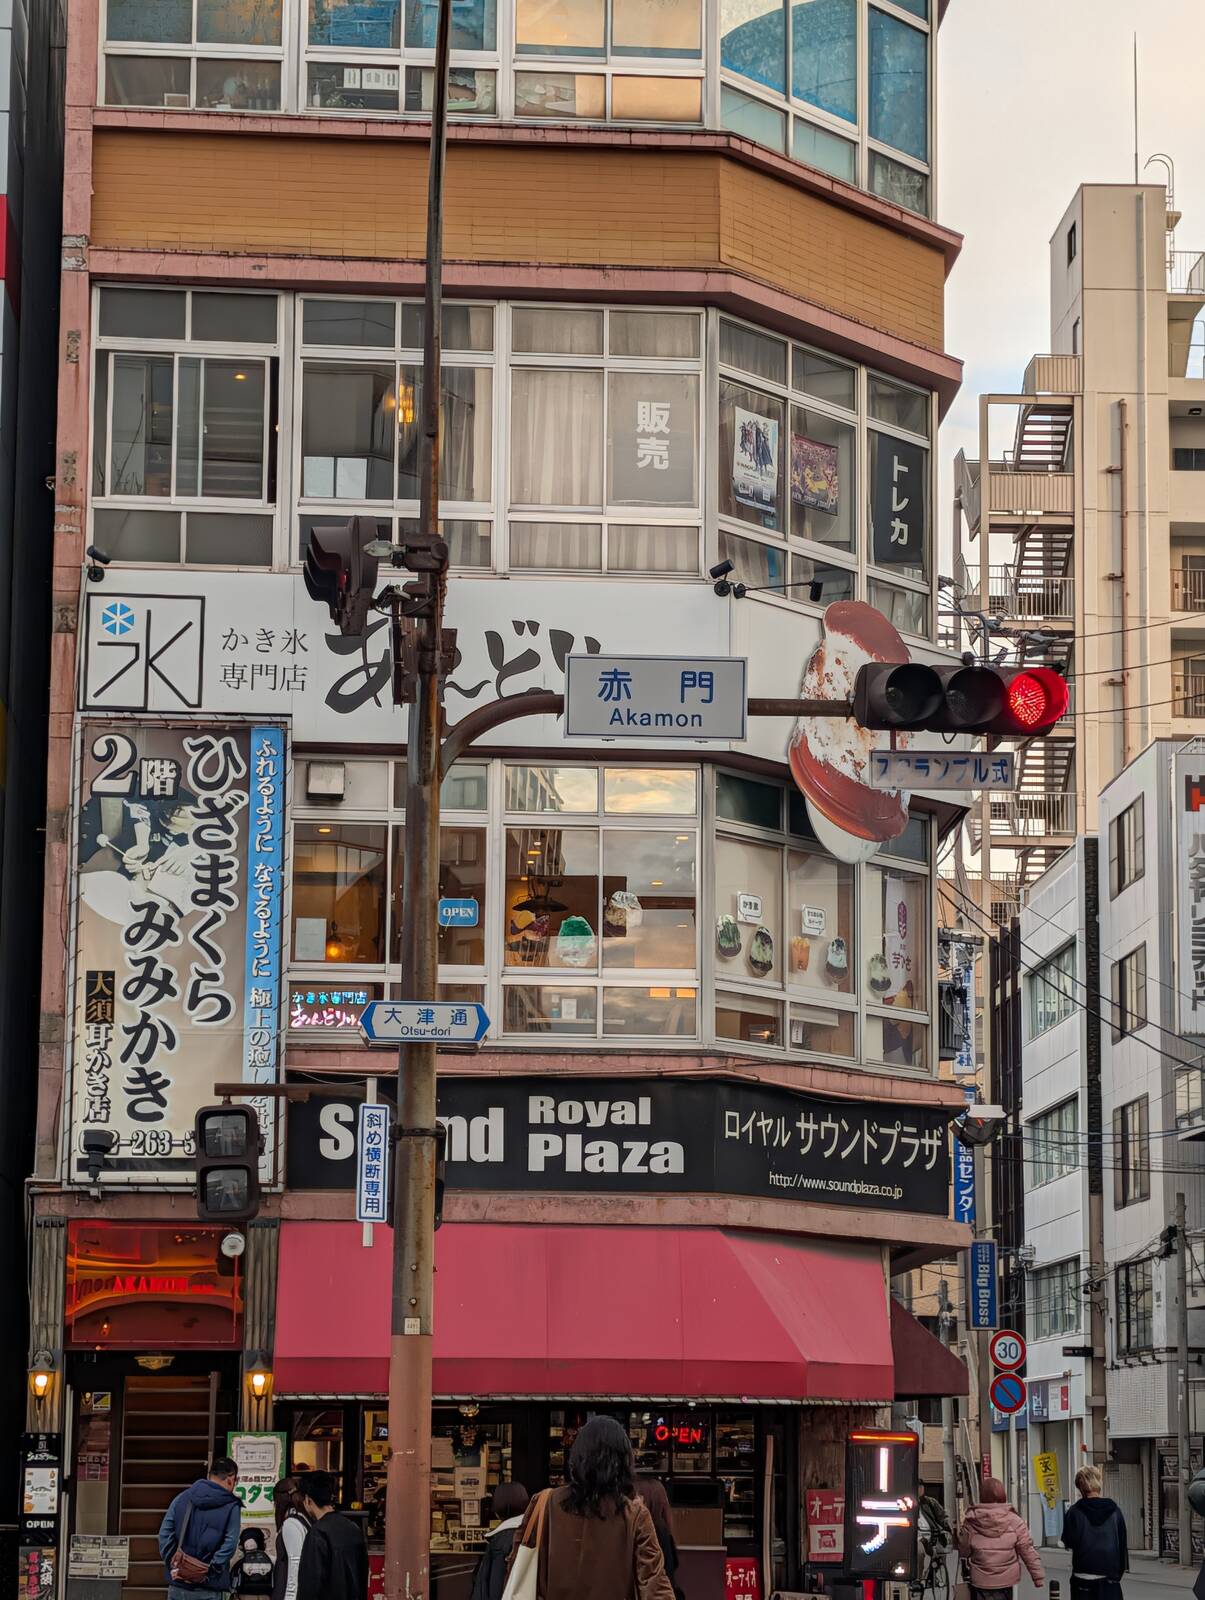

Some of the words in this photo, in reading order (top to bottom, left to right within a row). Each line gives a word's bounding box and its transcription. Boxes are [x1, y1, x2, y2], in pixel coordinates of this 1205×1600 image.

[636, 401, 671, 471] 販売
[890, 455, 909, 546] トレカ
[221, 627, 309, 654] かき氷
[219, 662, 308, 693] 専門店
[597, 668, 714, 704] 赤門
[609, 707, 703, 728] Akamon
[91, 734, 181, 799] 2階
[255, 738, 278, 853] ふれるように
[184, 737, 248, 1024] ひざまくら
[251, 862, 276, 978] なでるように
[442, 907, 474, 917] OPEN
[119, 899, 182, 1123] みみかき
[292, 991, 368, 1005] かき氷専門店
[384, 1007, 469, 1026] 大津通
[83, 972, 114, 1123] 大須耳かき店
[400, 1025, 451, 1036] Otsu-dori
[528, 1095, 651, 1128] Royal
[319, 1103, 504, 1163] Snd
[724, 1109, 791, 1148] ロイヤル
[795, 1113, 944, 1171] サウンドプラザ
[364, 1112, 383, 1214] 斜め横断専用
[528, 1132, 684, 1174] Plaza
[768, 1170, 903, 1200] http://www.soundplaza.co.jp
[978, 1289, 991, 1326] Boss
[998, 1342, 1019, 1360] 30
[26, 1520, 55, 1529] OPEN
